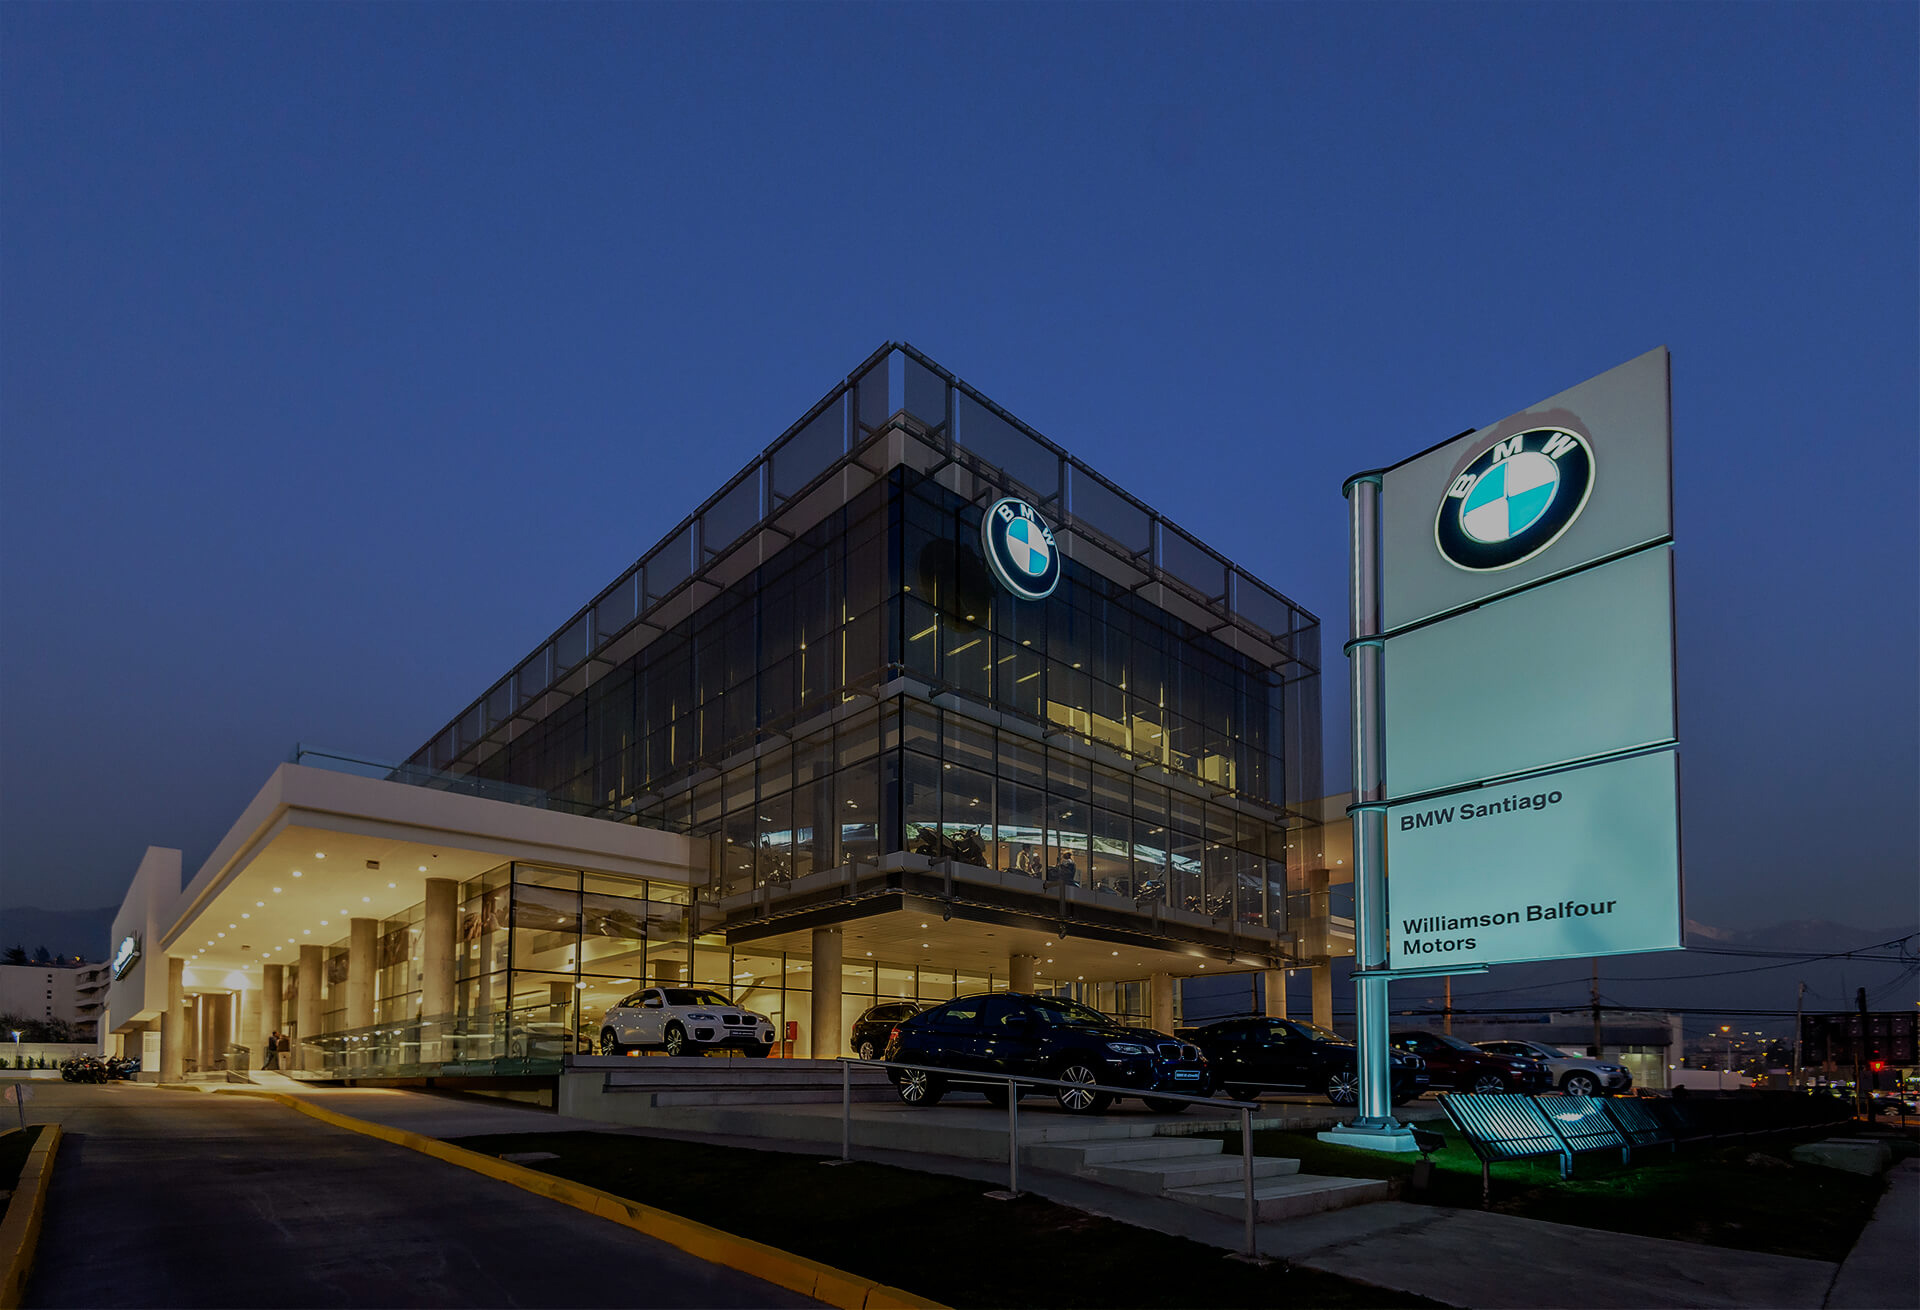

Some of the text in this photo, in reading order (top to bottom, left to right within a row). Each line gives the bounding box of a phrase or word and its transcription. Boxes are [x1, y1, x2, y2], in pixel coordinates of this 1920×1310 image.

[1449, 432, 1578, 499] BMW
[997, 504, 1055, 546] BMW
[1400, 790, 1563, 832] BMW Santiago
[1402, 900, 1617, 935] Williamson Balfour
[1403, 937, 1477, 956] Motors
